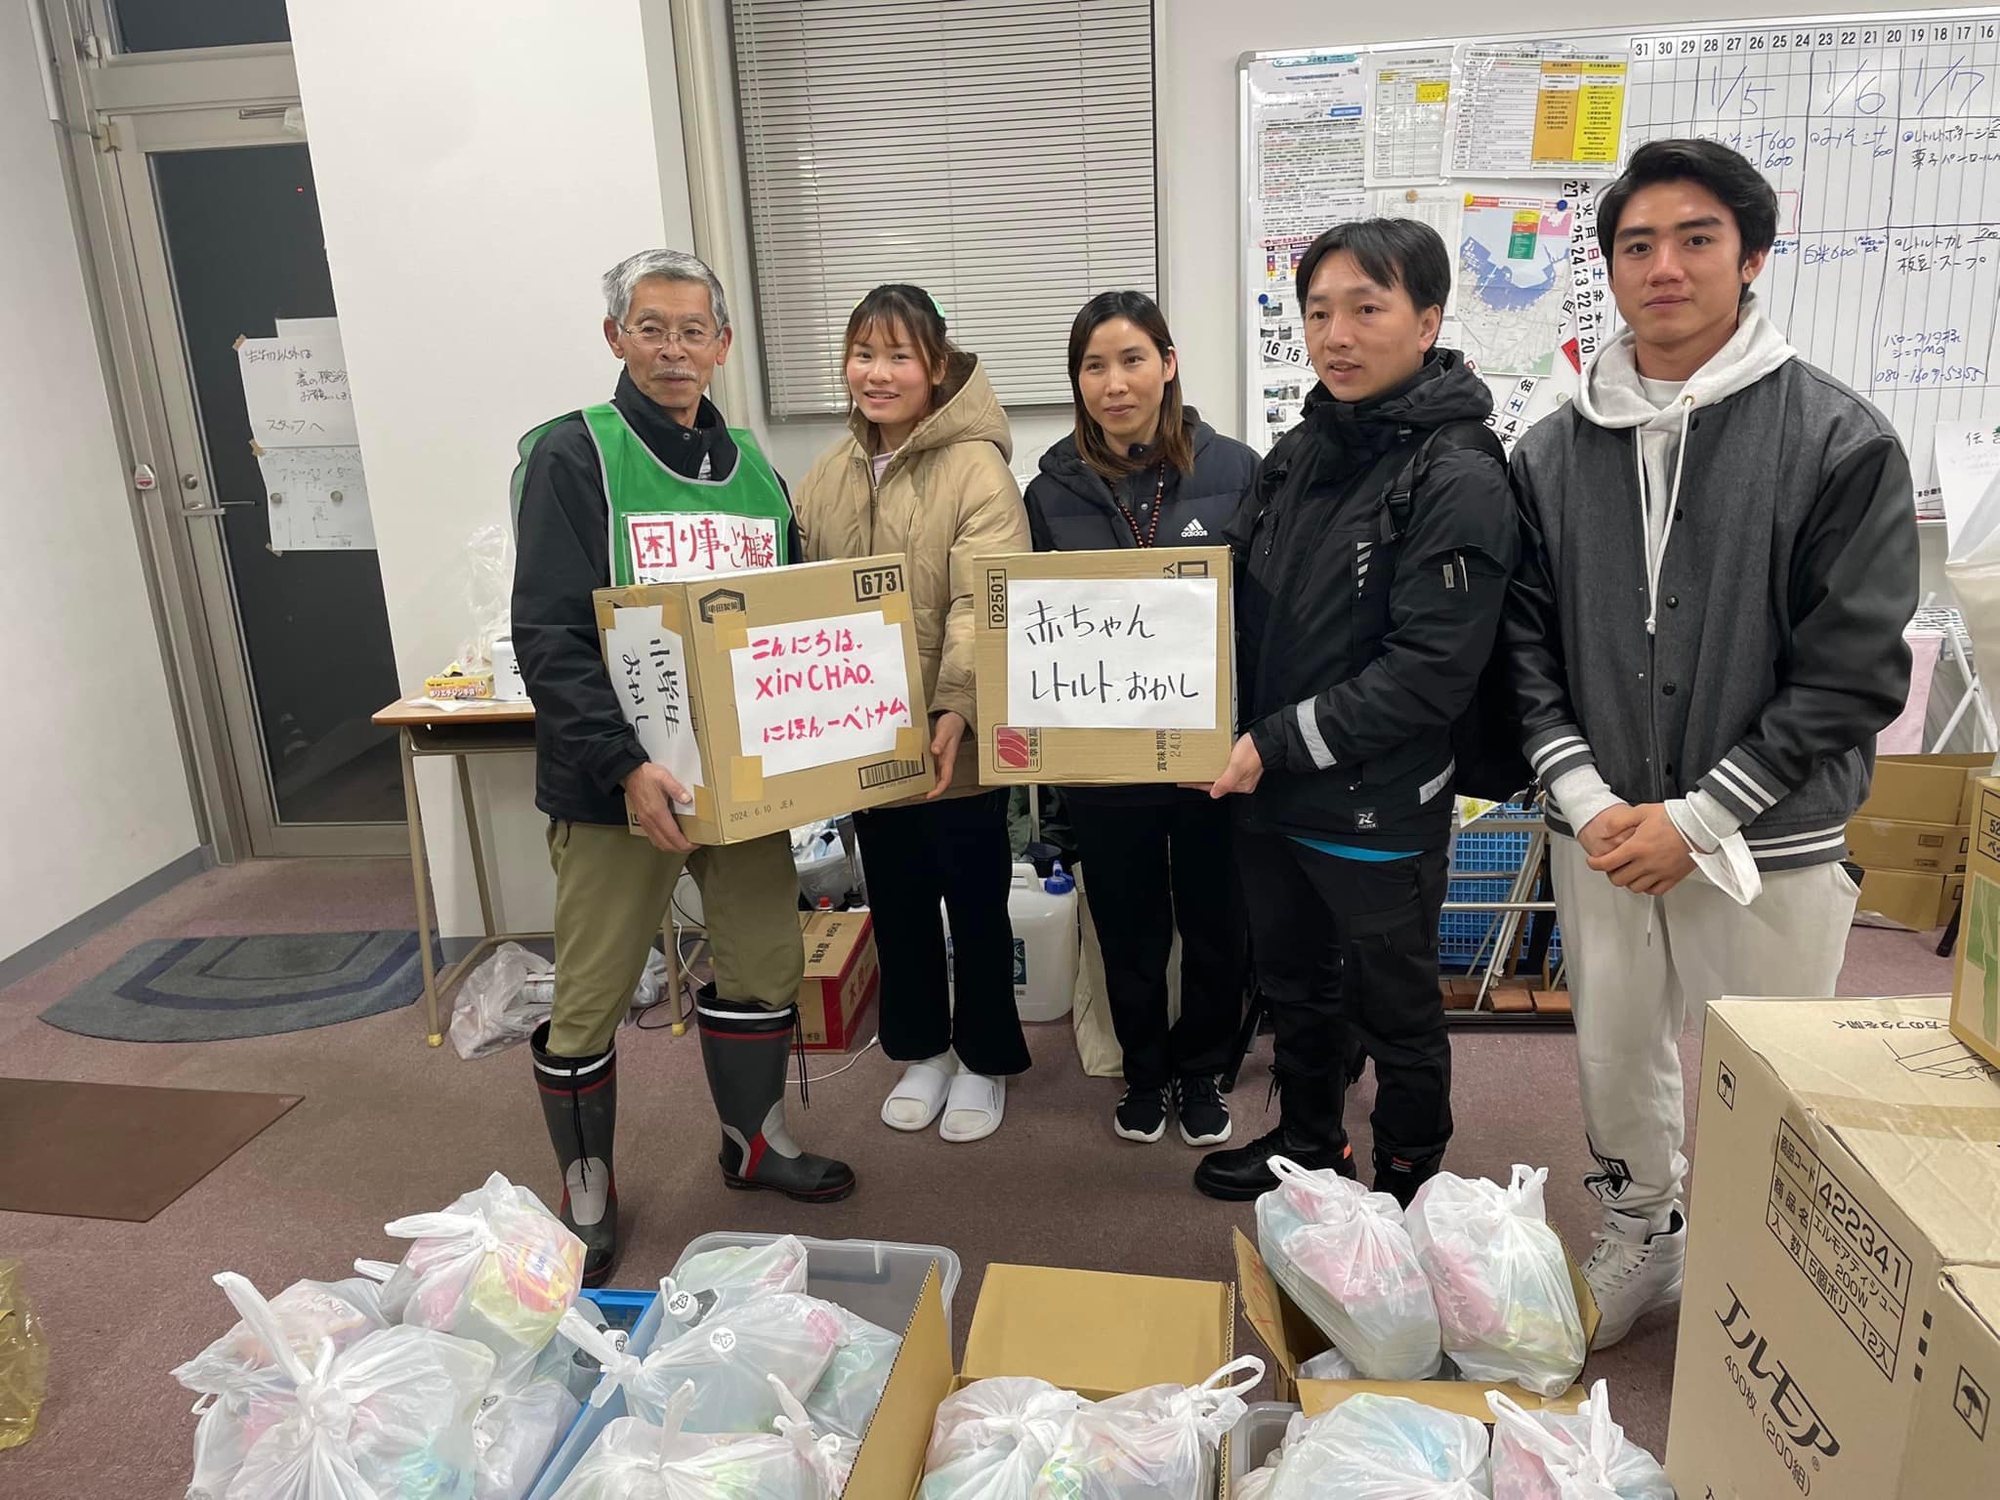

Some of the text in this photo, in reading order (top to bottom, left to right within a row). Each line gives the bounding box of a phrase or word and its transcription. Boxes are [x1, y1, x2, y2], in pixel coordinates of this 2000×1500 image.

[1635, 25, 1994, 56] 31 30 29 28 27 26 25 24 23 22 21 20 19 18 17 16
[1712, 55, 1985, 116] 1/5 1/6 1/7
[1564, 180, 1579, 198] 27
[1582, 202, 1593, 215] 火
[1585, 226, 1597, 239] 月
[1571, 247, 1587, 266] 24
[1588, 247, 1600, 260] 日
[1592, 267, 1605, 280] 土
[1576, 291, 1592, 310] 22
[1579, 314, 1594, 331] 21
[1264, 339, 1281, 356] 16
[1285, 346, 1301, 363] 15
[1580, 336, 1596, 354] 20
[1510, 398, 1525, 412] 土
[1504, 420, 1517, 434] 4
[1181, 528, 1208, 538] adidas
[860, 570, 898, 596] 673
[990, 574, 1005, 624] 02501
[1024, 600, 1156, 646] 赤ちゃん
[621, 646, 649, 735] おかし
[649, 637, 681, 739] 小学生
[1781, 1134, 1816, 1185] 商品コード
[1773, 1175, 1810, 1231] 商品名
[1770, 1211, 1802, 1259] 入数
[1818, 1182, 1902, 1289] 422341
[1813, 1213, 1900, 1320] エルモアティシュー
[1834, 1263, 1869, 1310] 200W
[1808, 1257, 1889, 1370] 5個ポリ 12入
[1714, 1282, 1841, 1458] エルモア
[1724, 1354, 1811, 1497] 400枚 (200組)
